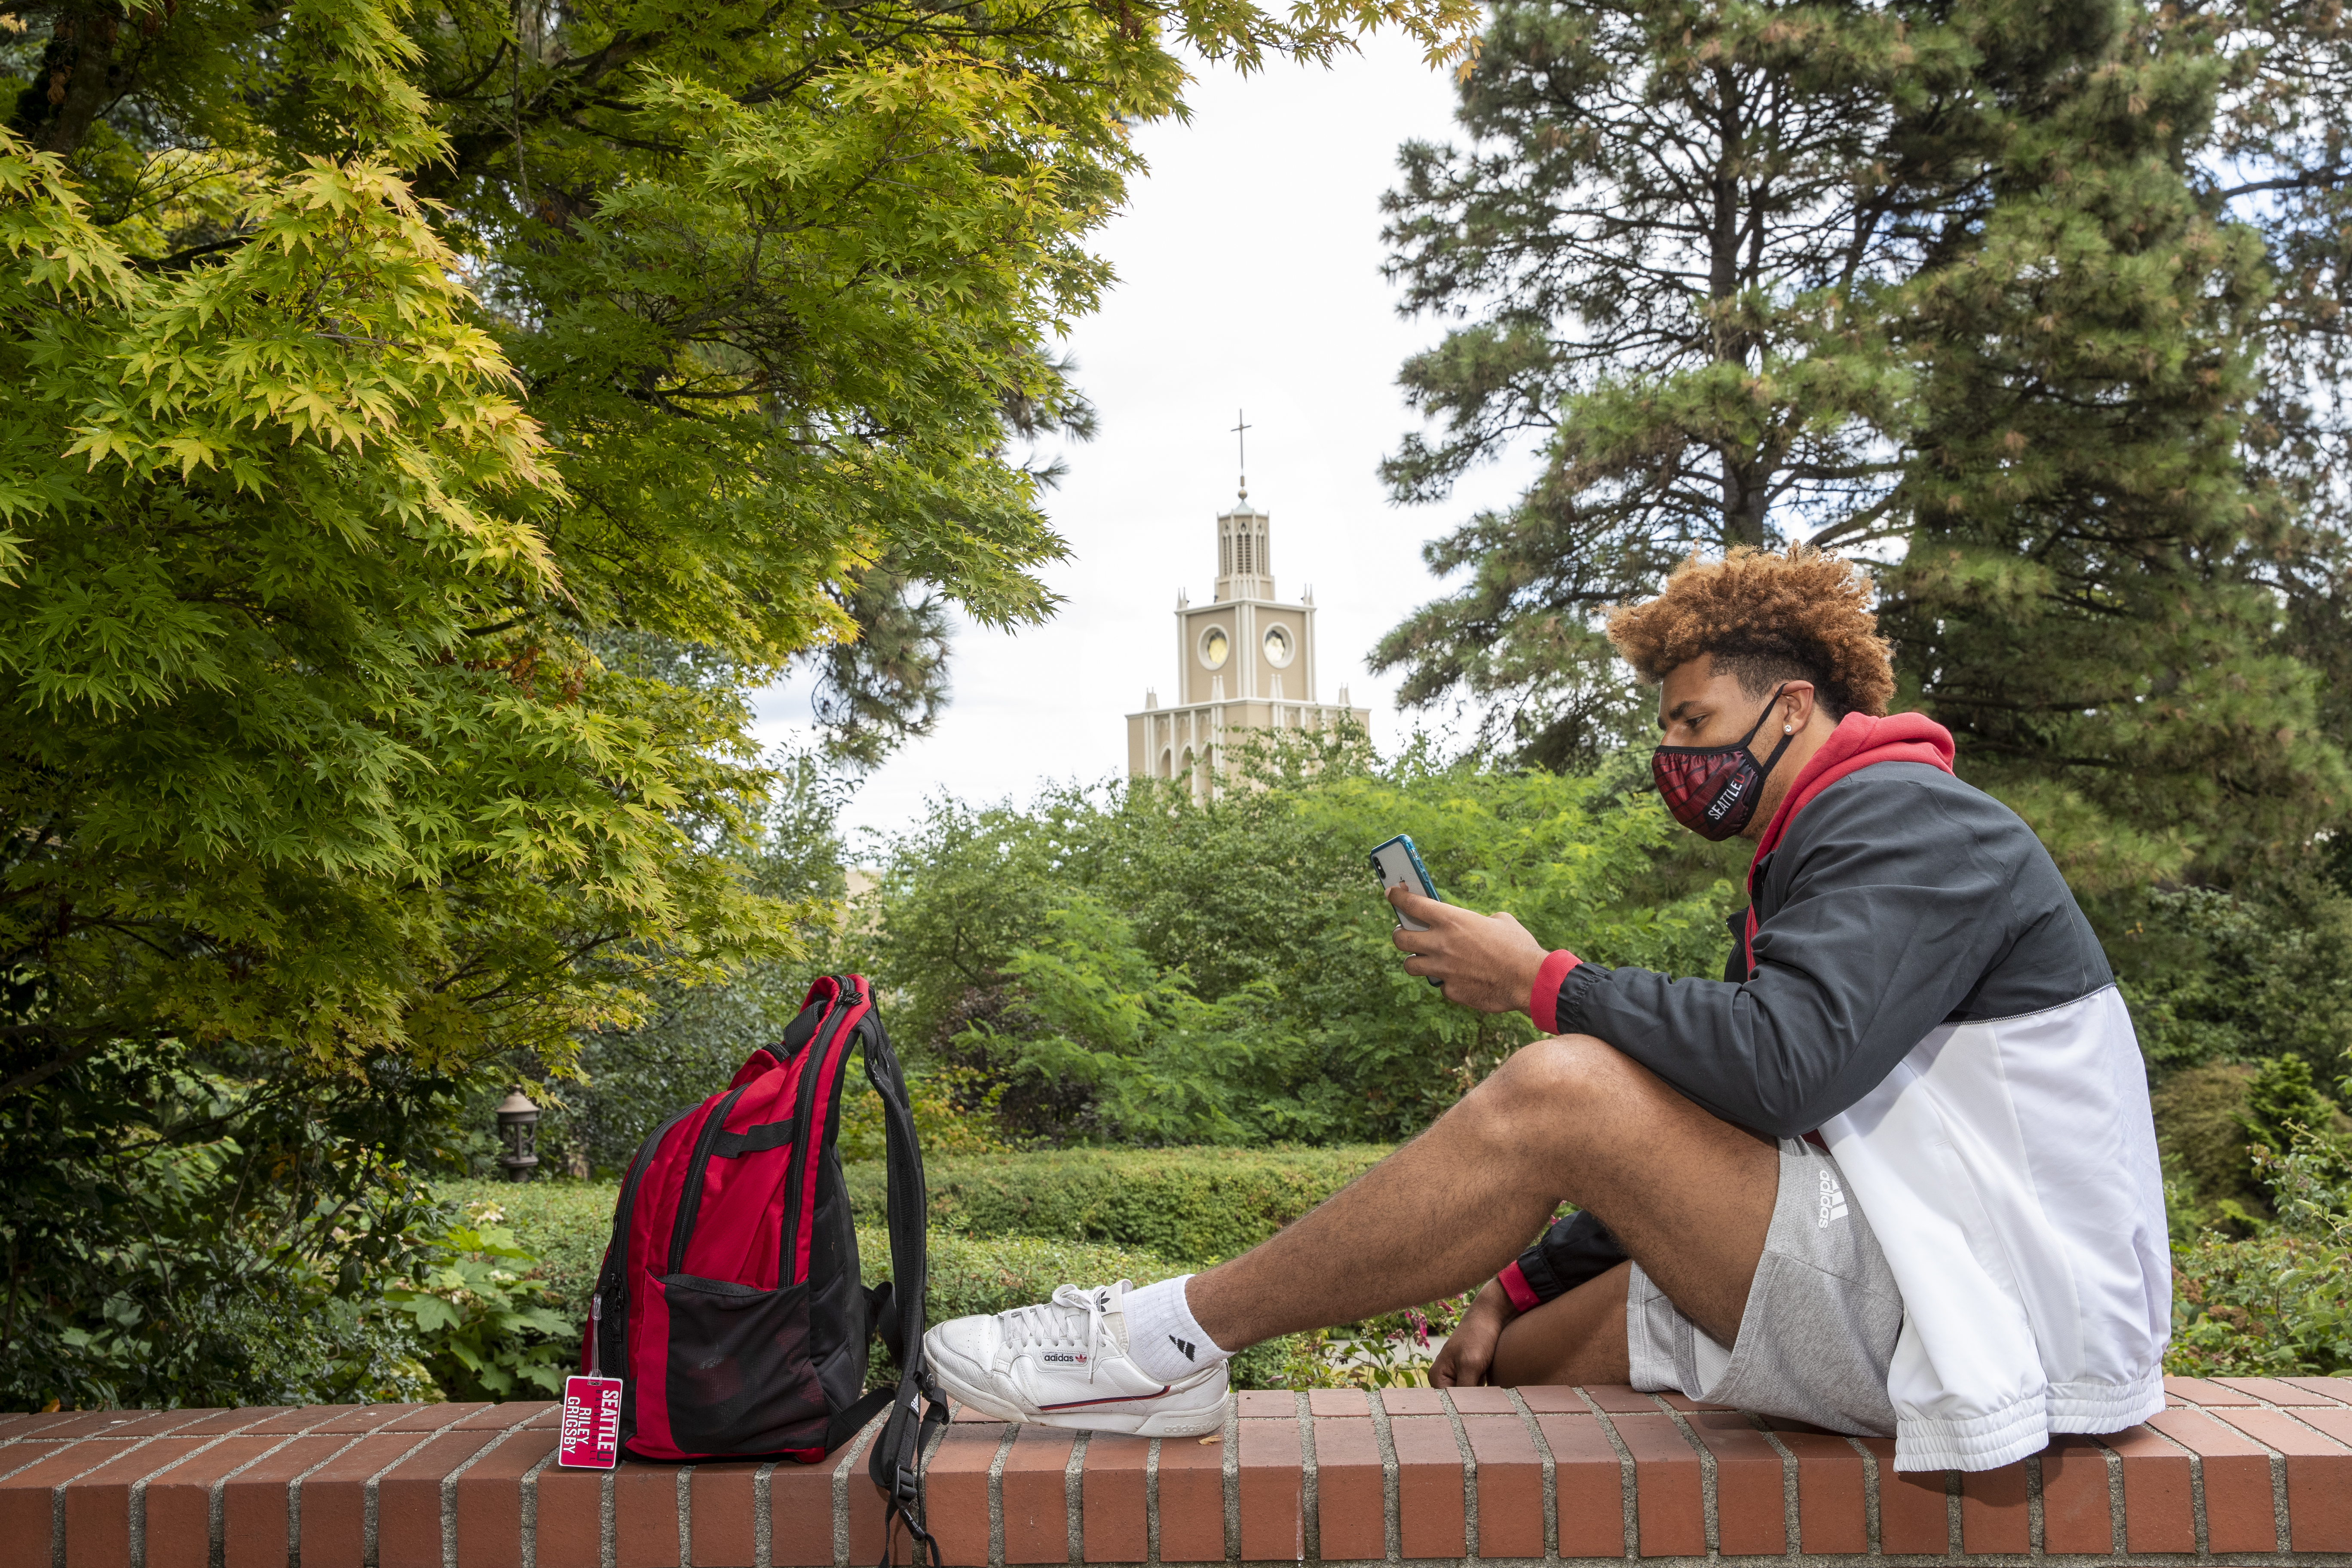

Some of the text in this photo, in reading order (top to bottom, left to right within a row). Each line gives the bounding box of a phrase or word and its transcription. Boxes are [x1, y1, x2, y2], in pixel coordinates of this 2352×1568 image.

[1708, 773, 1746, 820] SEATTLEU
[1818, 1170, 1834, 1228] adidas
[1044, 1353, 1074, 1363] adidas
[563, 1396, 580, 1454] GRIGSBY
[577, 1407, 592, 1445] RILEY
[589, 1390, 602, 1461] BASKETBALL
[597, 1390, 619, 1462] SEATTLEU
[1164, 1424, 1200, 1433] adidas
